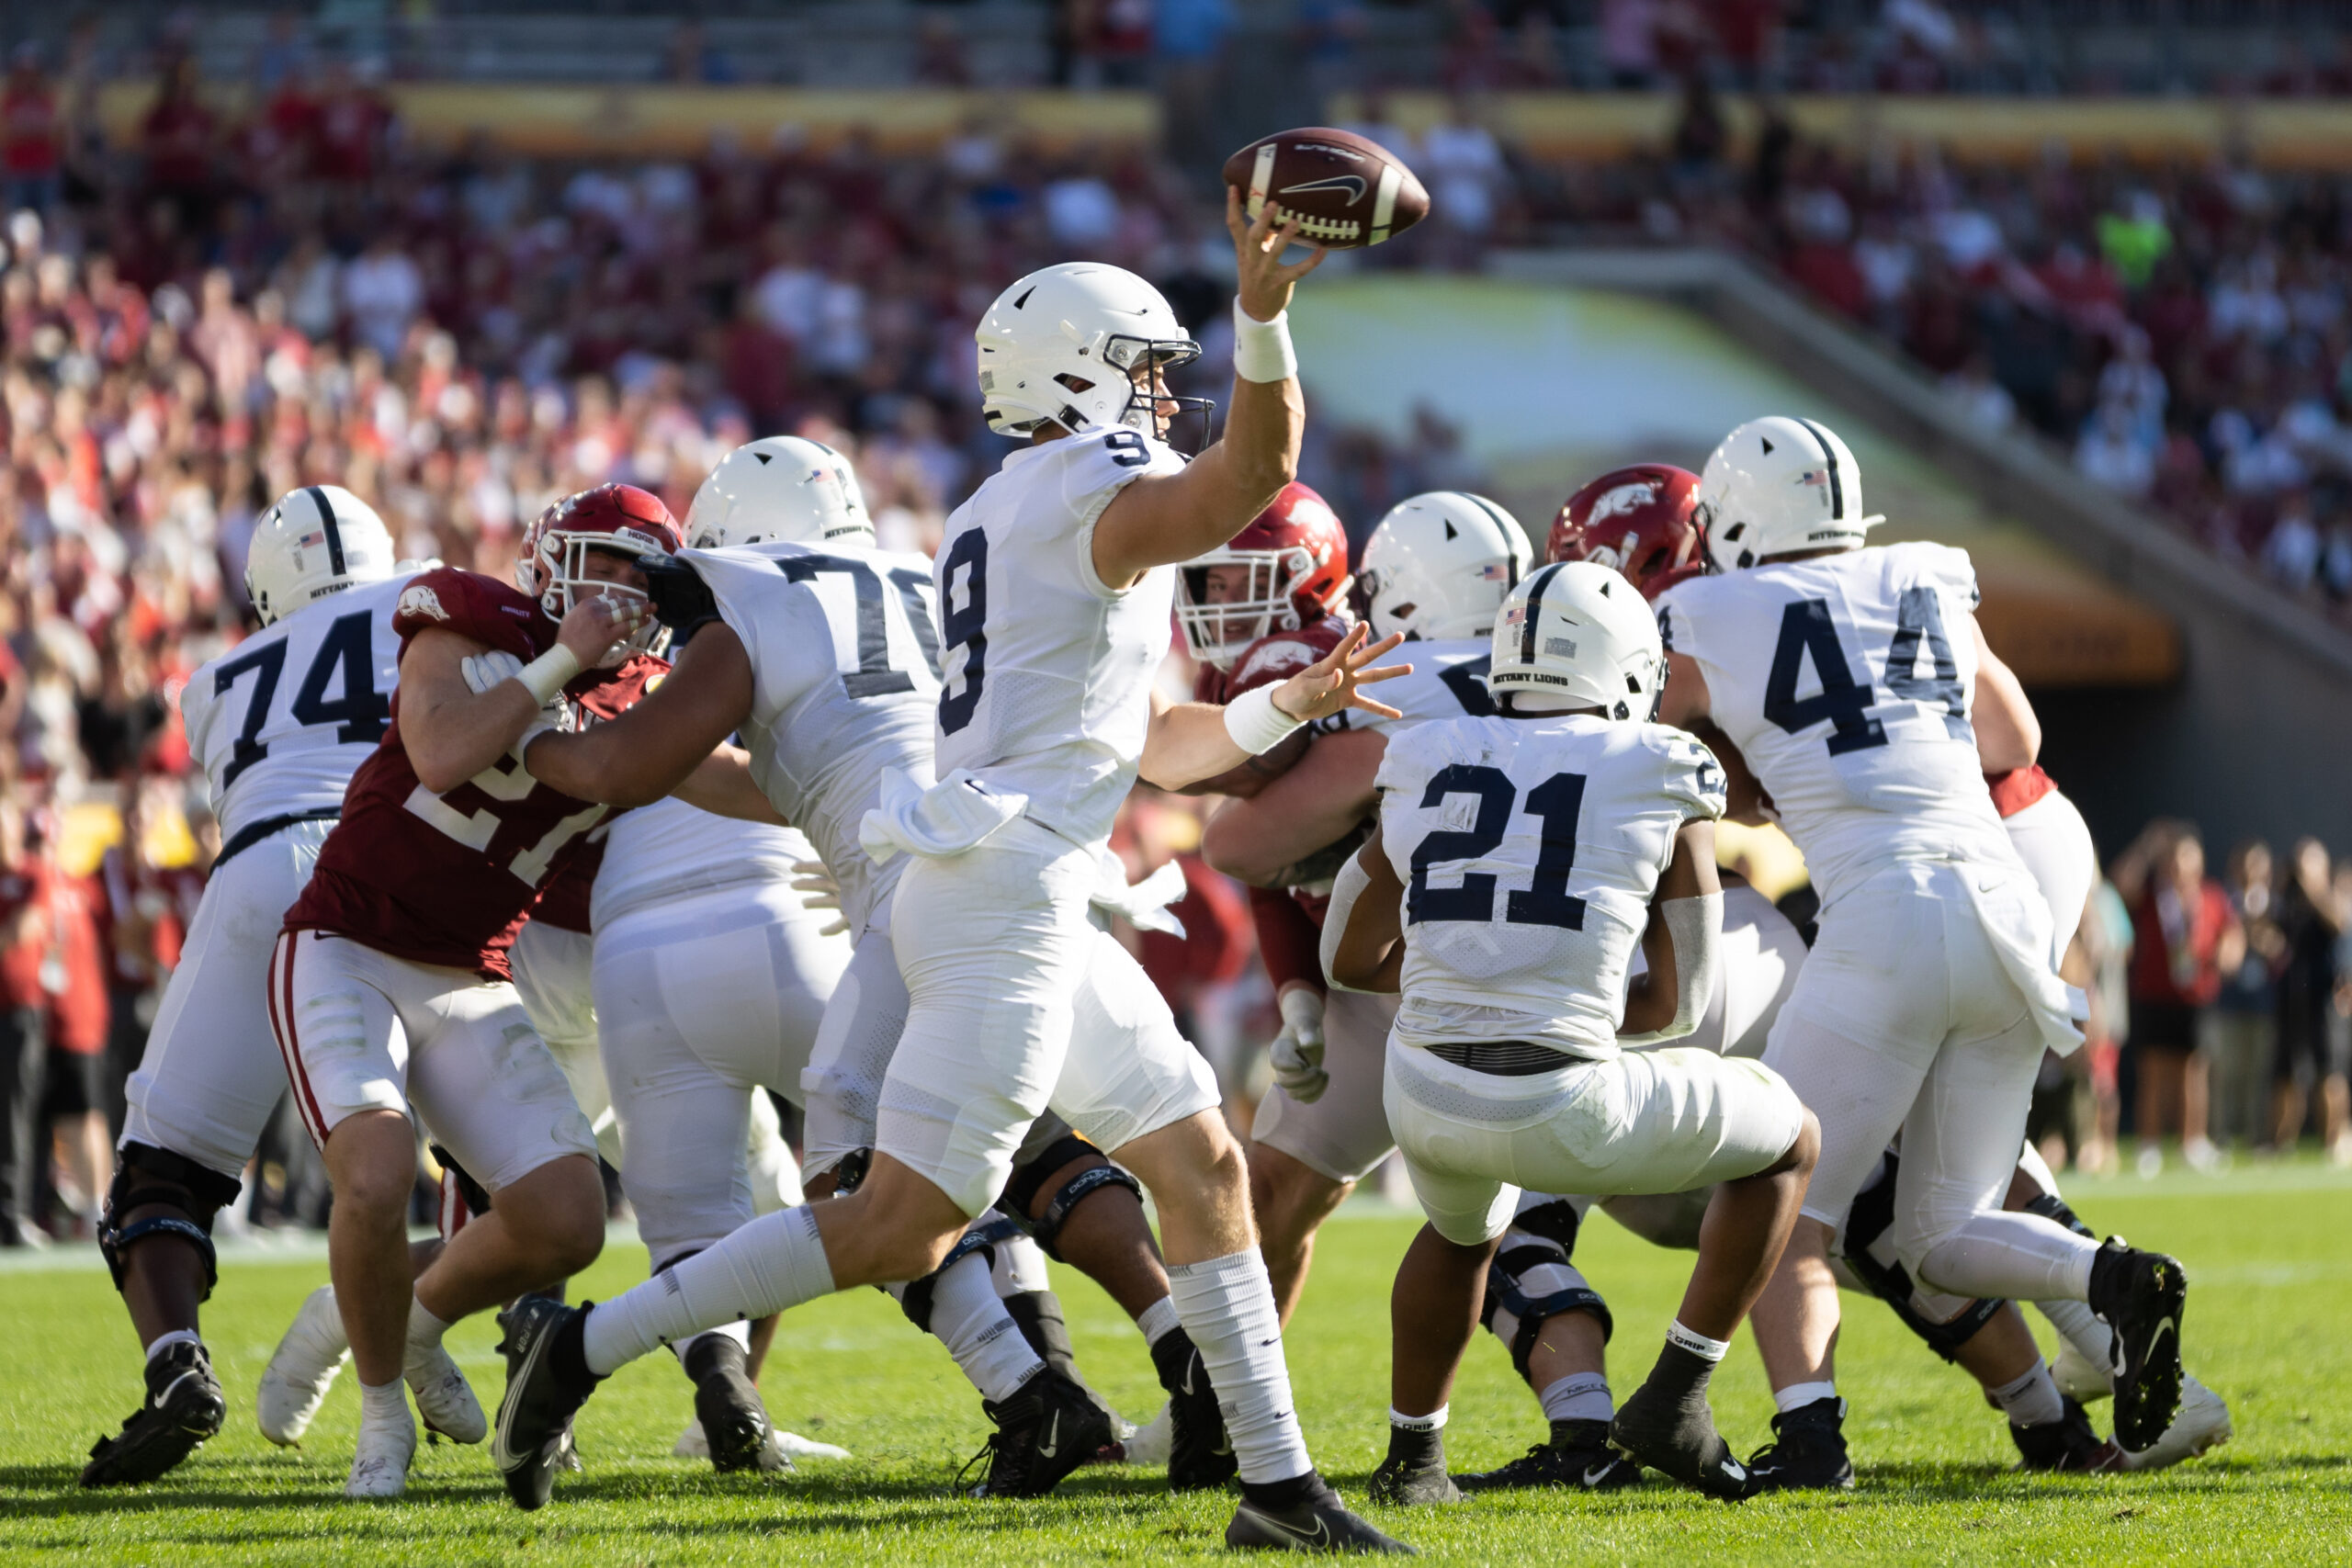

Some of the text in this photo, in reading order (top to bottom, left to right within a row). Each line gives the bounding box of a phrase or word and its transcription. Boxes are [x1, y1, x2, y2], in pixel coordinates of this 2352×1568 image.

[1104, 431, 1151, 467] 9
[628, 529, 654, 545] HOGS
[939, 525, 989, 738] 9
[1533, 673, 1569, 687] LIONS
[1763, 585, 1974, 757] 44
[213, 608, 393, 793] 74
[1407, 763, 1588, 931] 21
[1675, 1336, 1706, 1351] GRIP
[1402, 1423, 1434, 1431] GRIP
